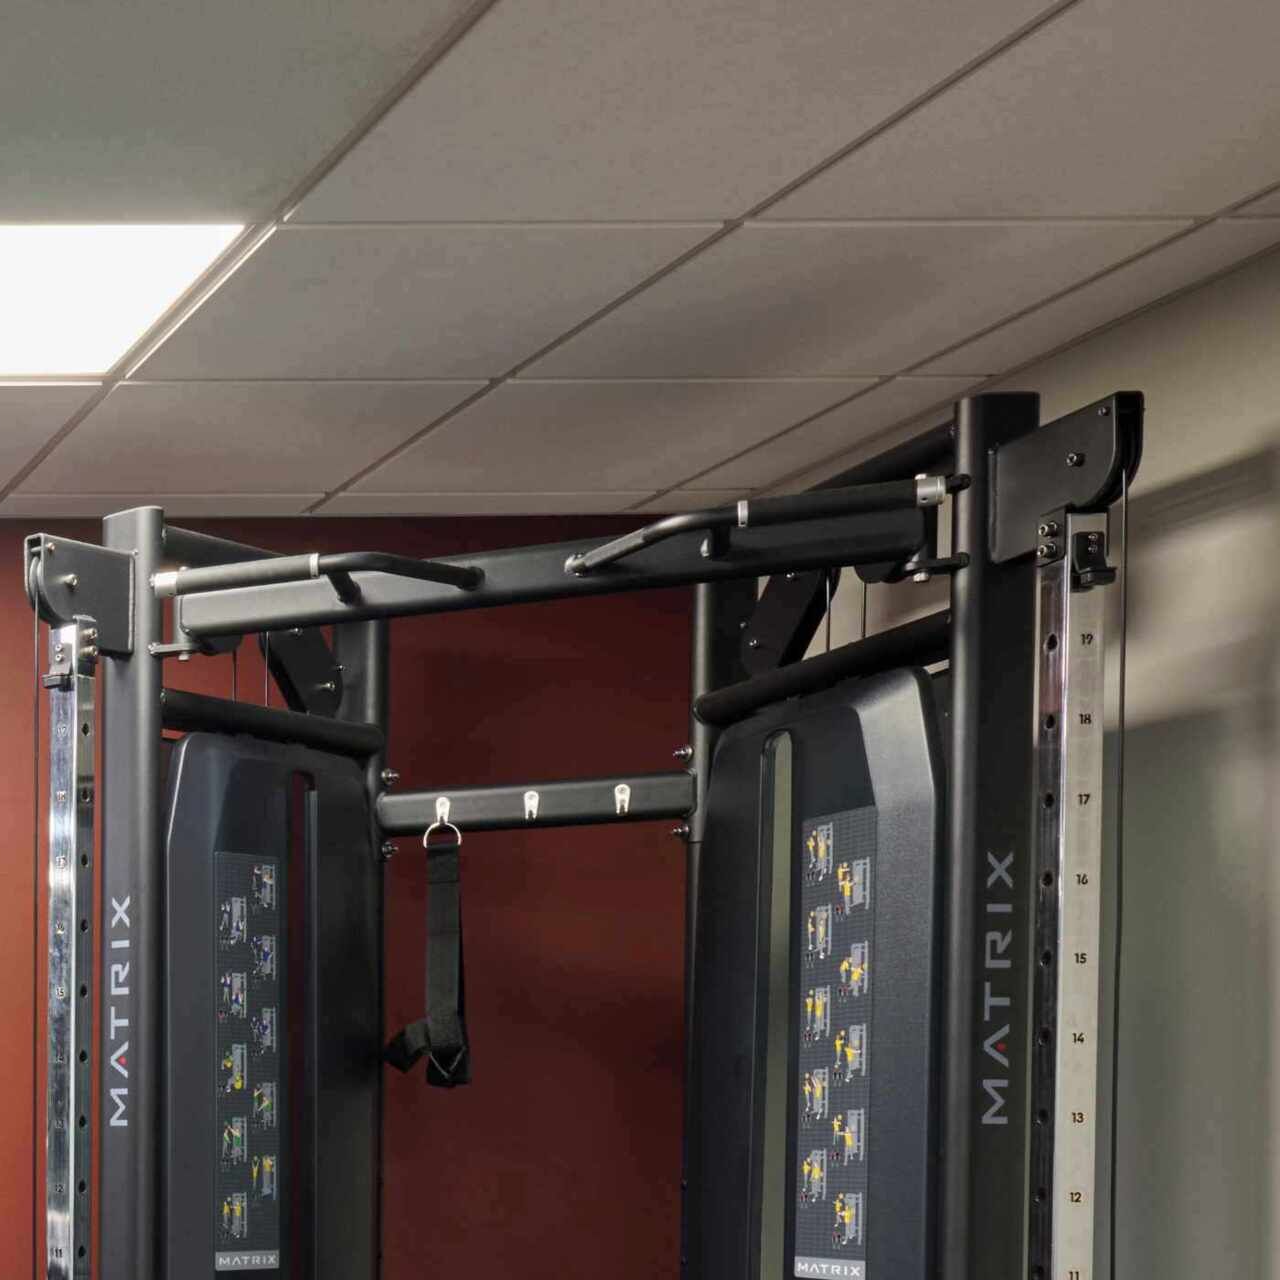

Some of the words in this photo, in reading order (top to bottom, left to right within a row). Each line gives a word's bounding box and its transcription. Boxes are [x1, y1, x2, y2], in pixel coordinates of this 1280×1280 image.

[1080, 633, 1093, 645] 19
[1079, 713, 1092, 725] 18
[1077, 794, 1091, 805] 17
[1076, 874, 1088, 885] 16
[1074, 953, 1087, 964] 15
[981, 851, 1014, 1125] MATRIX
[109, 895, 130, 1126] MATRIX
[1072, 1033, 1085, 1044] 14
[1071, 1112, 1084, 1124] 13
[1070, 1192, 1082, 1203] 12
[219, 1255, 277, 1265] MATRIX
[797, 1262, 861, 1277] MATRIX
